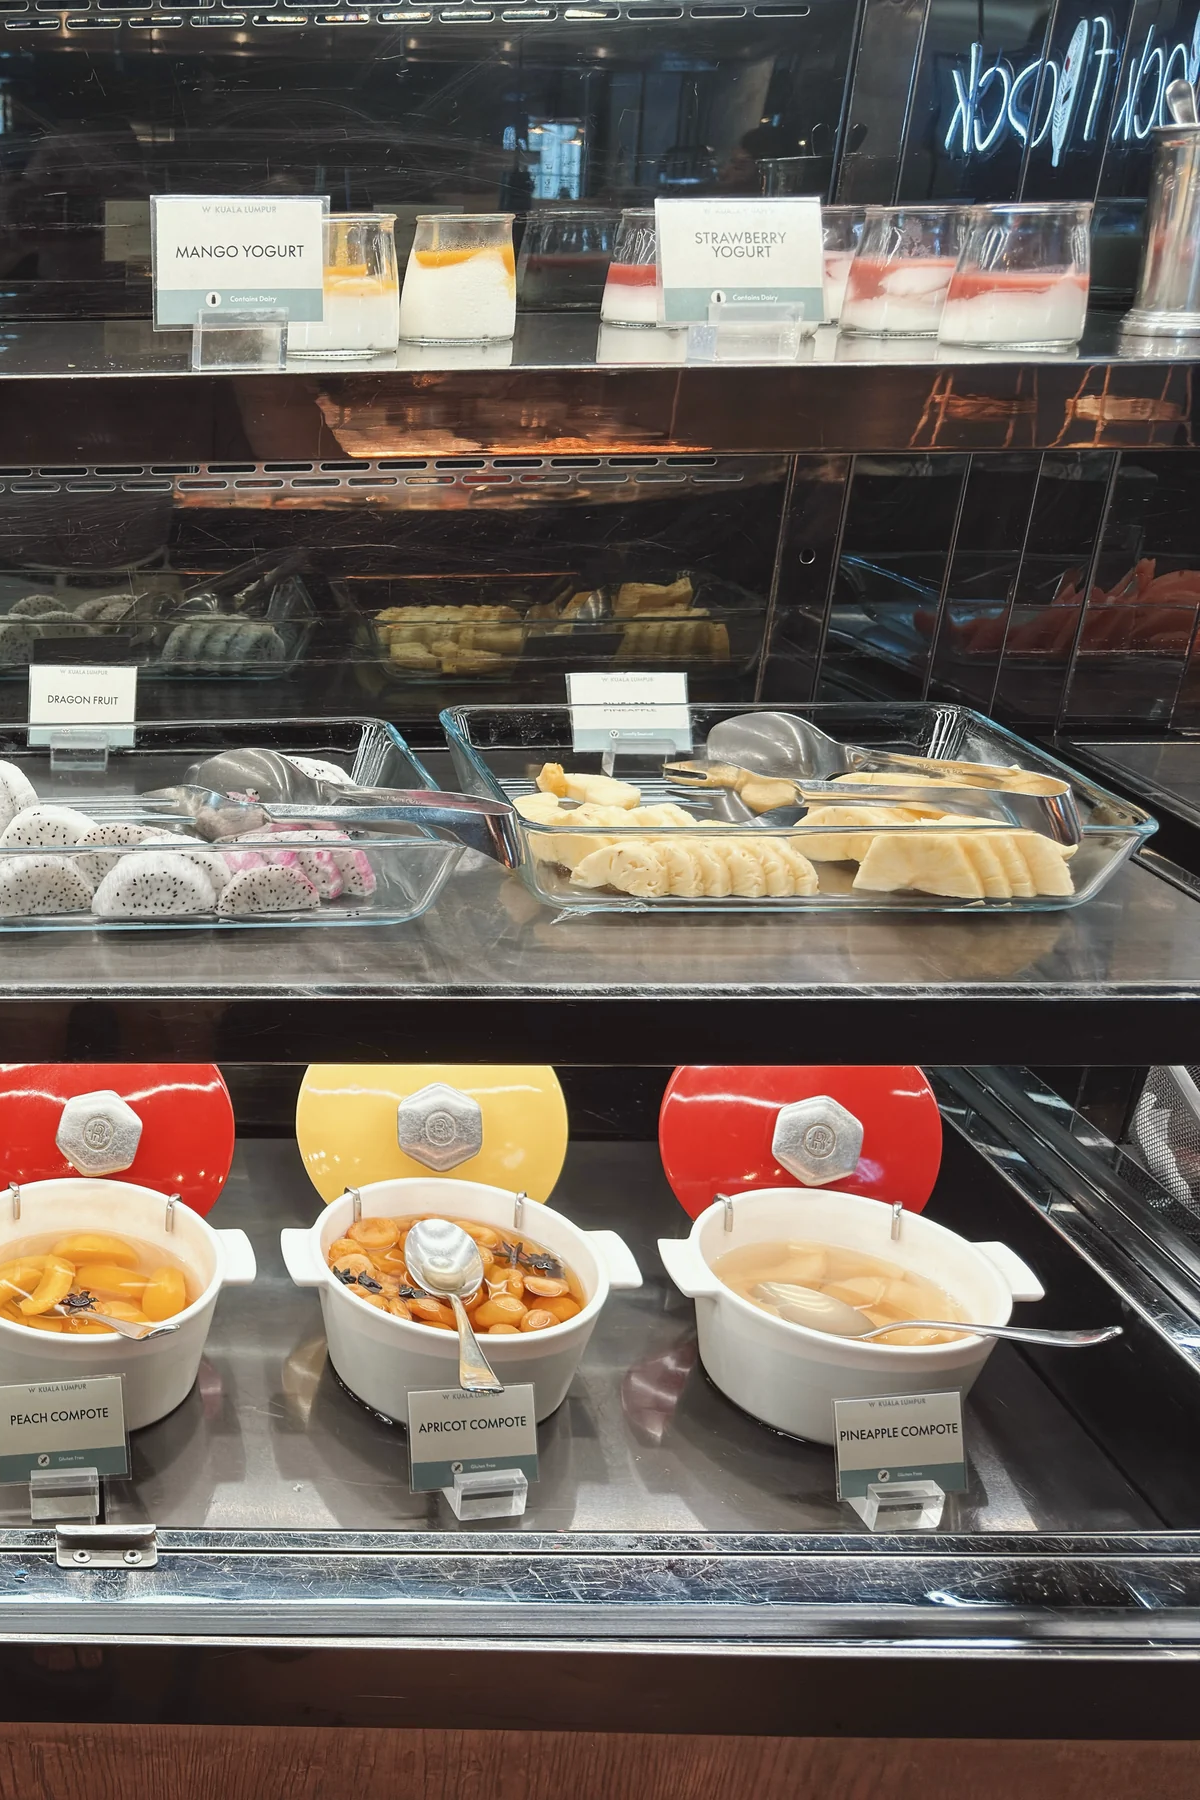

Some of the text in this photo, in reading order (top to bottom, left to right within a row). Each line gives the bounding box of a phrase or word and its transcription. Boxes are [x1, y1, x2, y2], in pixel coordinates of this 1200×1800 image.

[215, 206, 242, 214] KUALA
[244, 206, 277, 214] LUMPUR
[695, 232, 786, 244] STRAWBERRY
[176, 244, 304, 258] MANGO YOGURT
[711, 246, 772, 258] YOGURT
[259, 296, 277, 304] Dairy
[760, 294, 778, 302] Dairy
[47, 695, 118, 705] DRAGON FRUIT
[61, 1383, 87, 1392] LUMPUR
[452, 1392, 474, 1400] KUALA
[900, 1398, 926, 1406] LUMPUR
[10, 1407, 109, 1426] PEACH COMPOTE
[418, 1416, 526, 1434] APRICOT COMPOTE
[840, 1423, 958, 1442] PINEAPPLE COMPOTE
